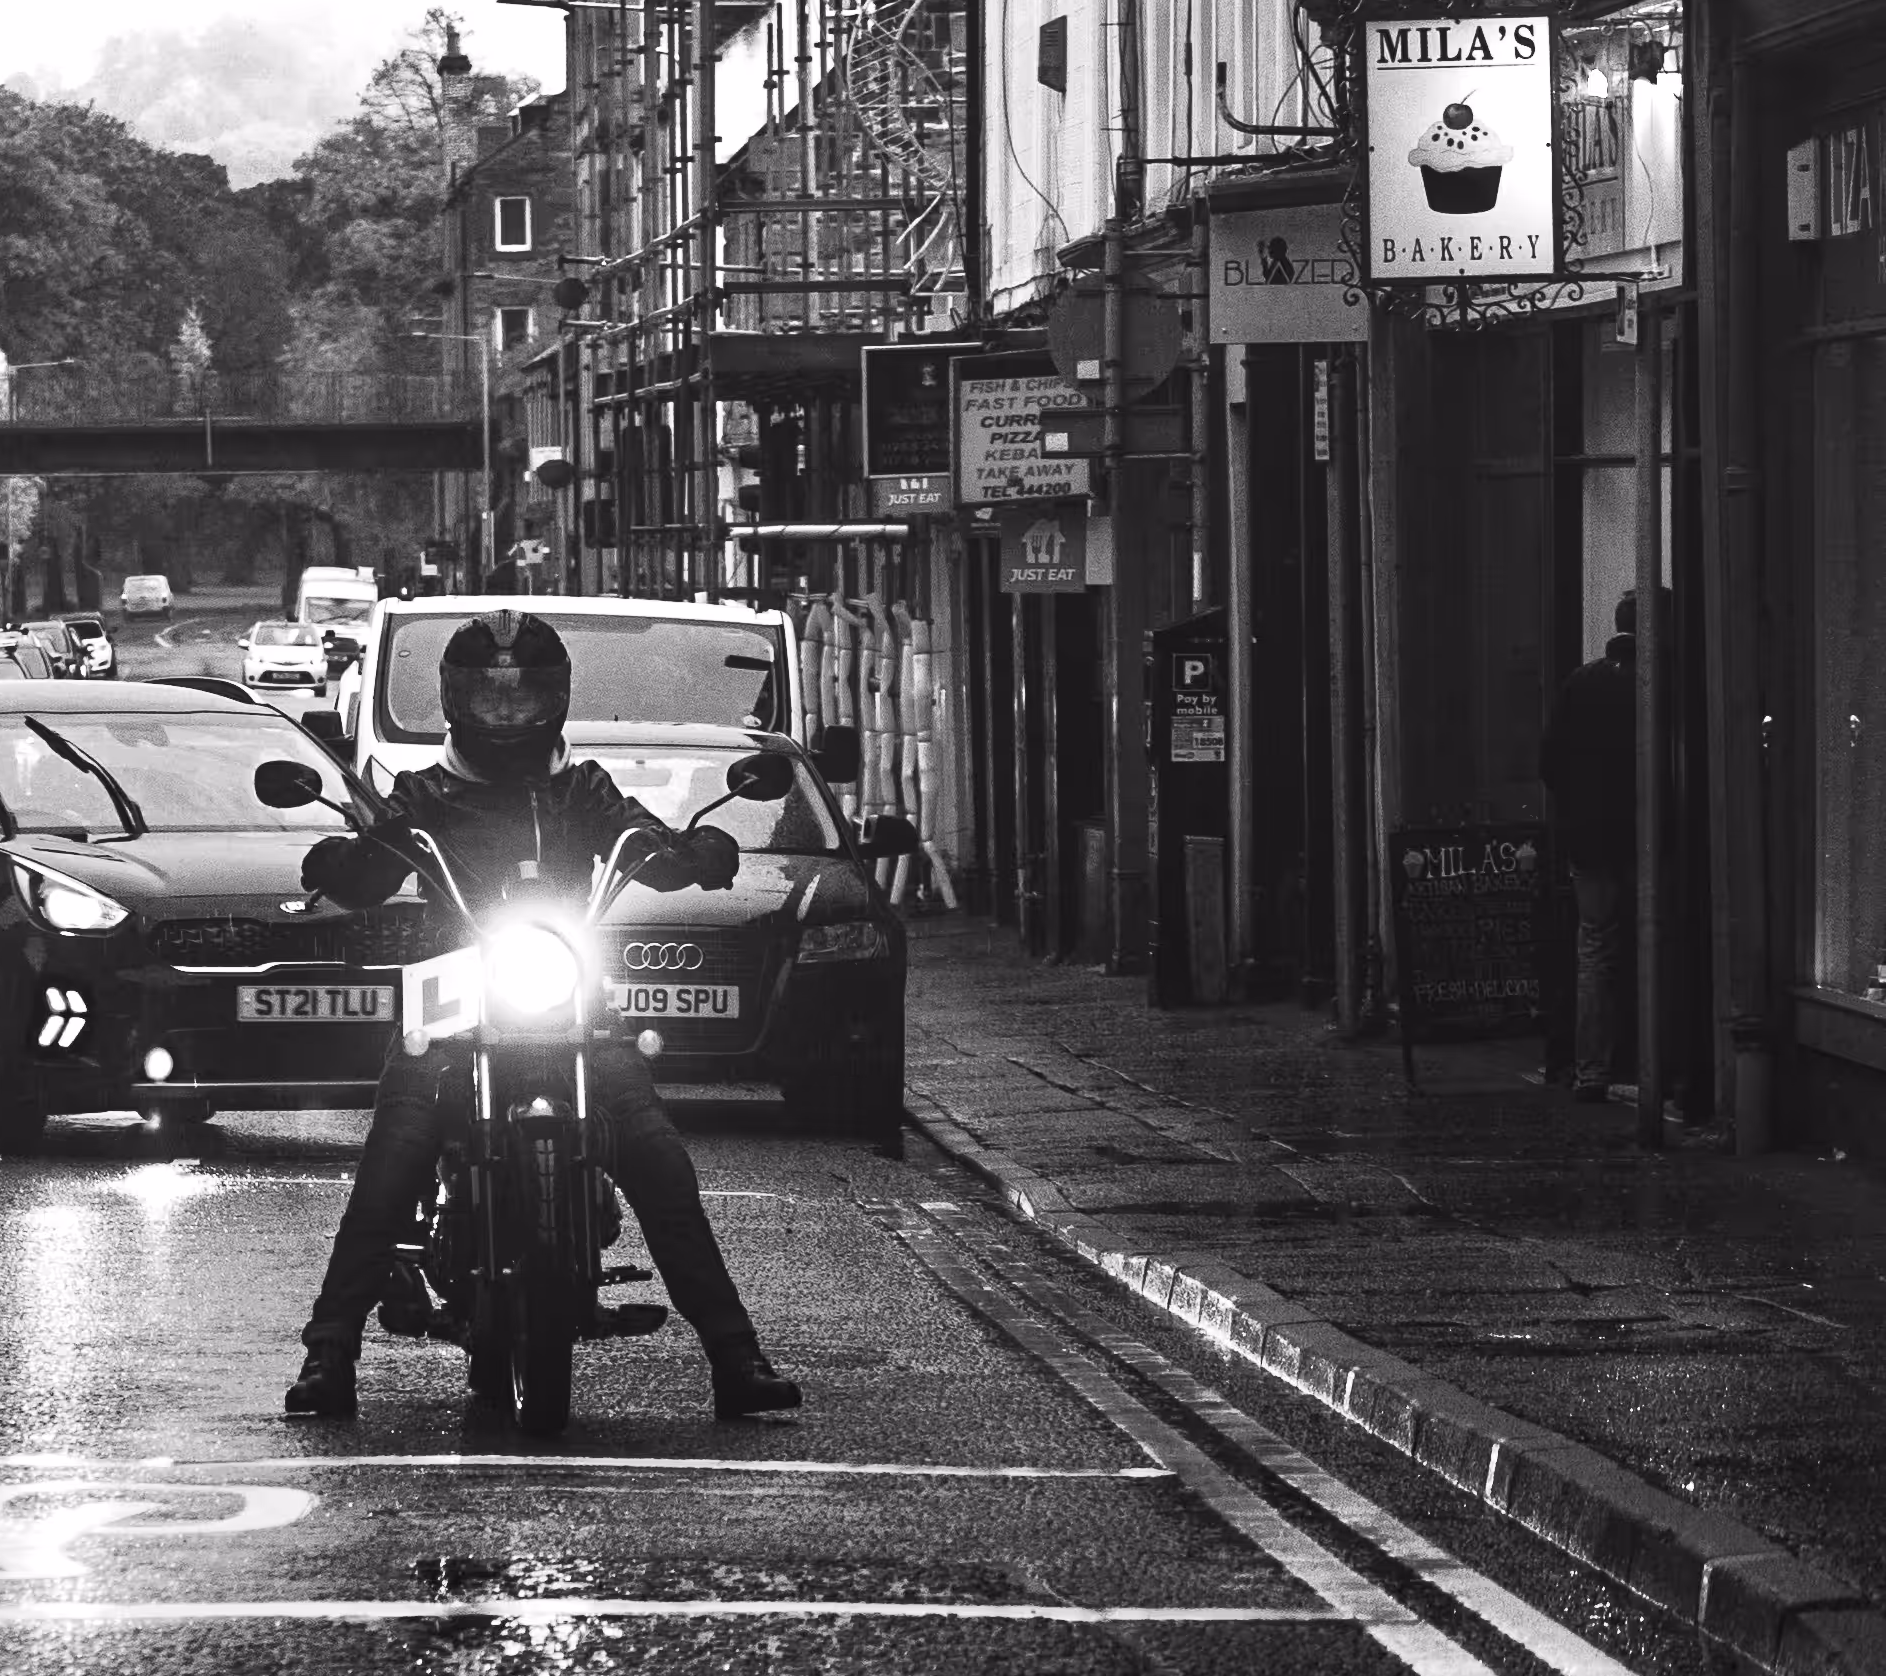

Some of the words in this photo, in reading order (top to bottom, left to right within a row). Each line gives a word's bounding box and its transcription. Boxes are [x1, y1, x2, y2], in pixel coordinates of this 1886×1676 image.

[1376, 24, 1536, 64] MILA'S
[1224, 258, 1355, 287] BLAZED
[969, 380, 1006, 394] FISH
[965, 396, 1018, 411] FAST
[1024, 393, 1082, 408] FOOD
[980, 413, 1042, 428] CURR
[985, 448, 1039, 461] KEBA
[977, 466, 1020, 480] TAKE
[1025, 463, 1075, 477] AWAY
[888, 493, 917, 506] JUST
[919, 492, 942, 503] EAT
[1010, 568, 1045, 583] JUST
[1048, 568, 1076, 581] EAT
[1184, 660, 1205, 685] P
[1176, 694, 1199, 705] Pay
[1202, 694, 1218, 705] by
[1176, 706, 1218, 715] mobile
[254, 989, 319, 1017] ST21
[325, 989, 378, 1017] TLU
[676, 987, 728, 1014] SPU
